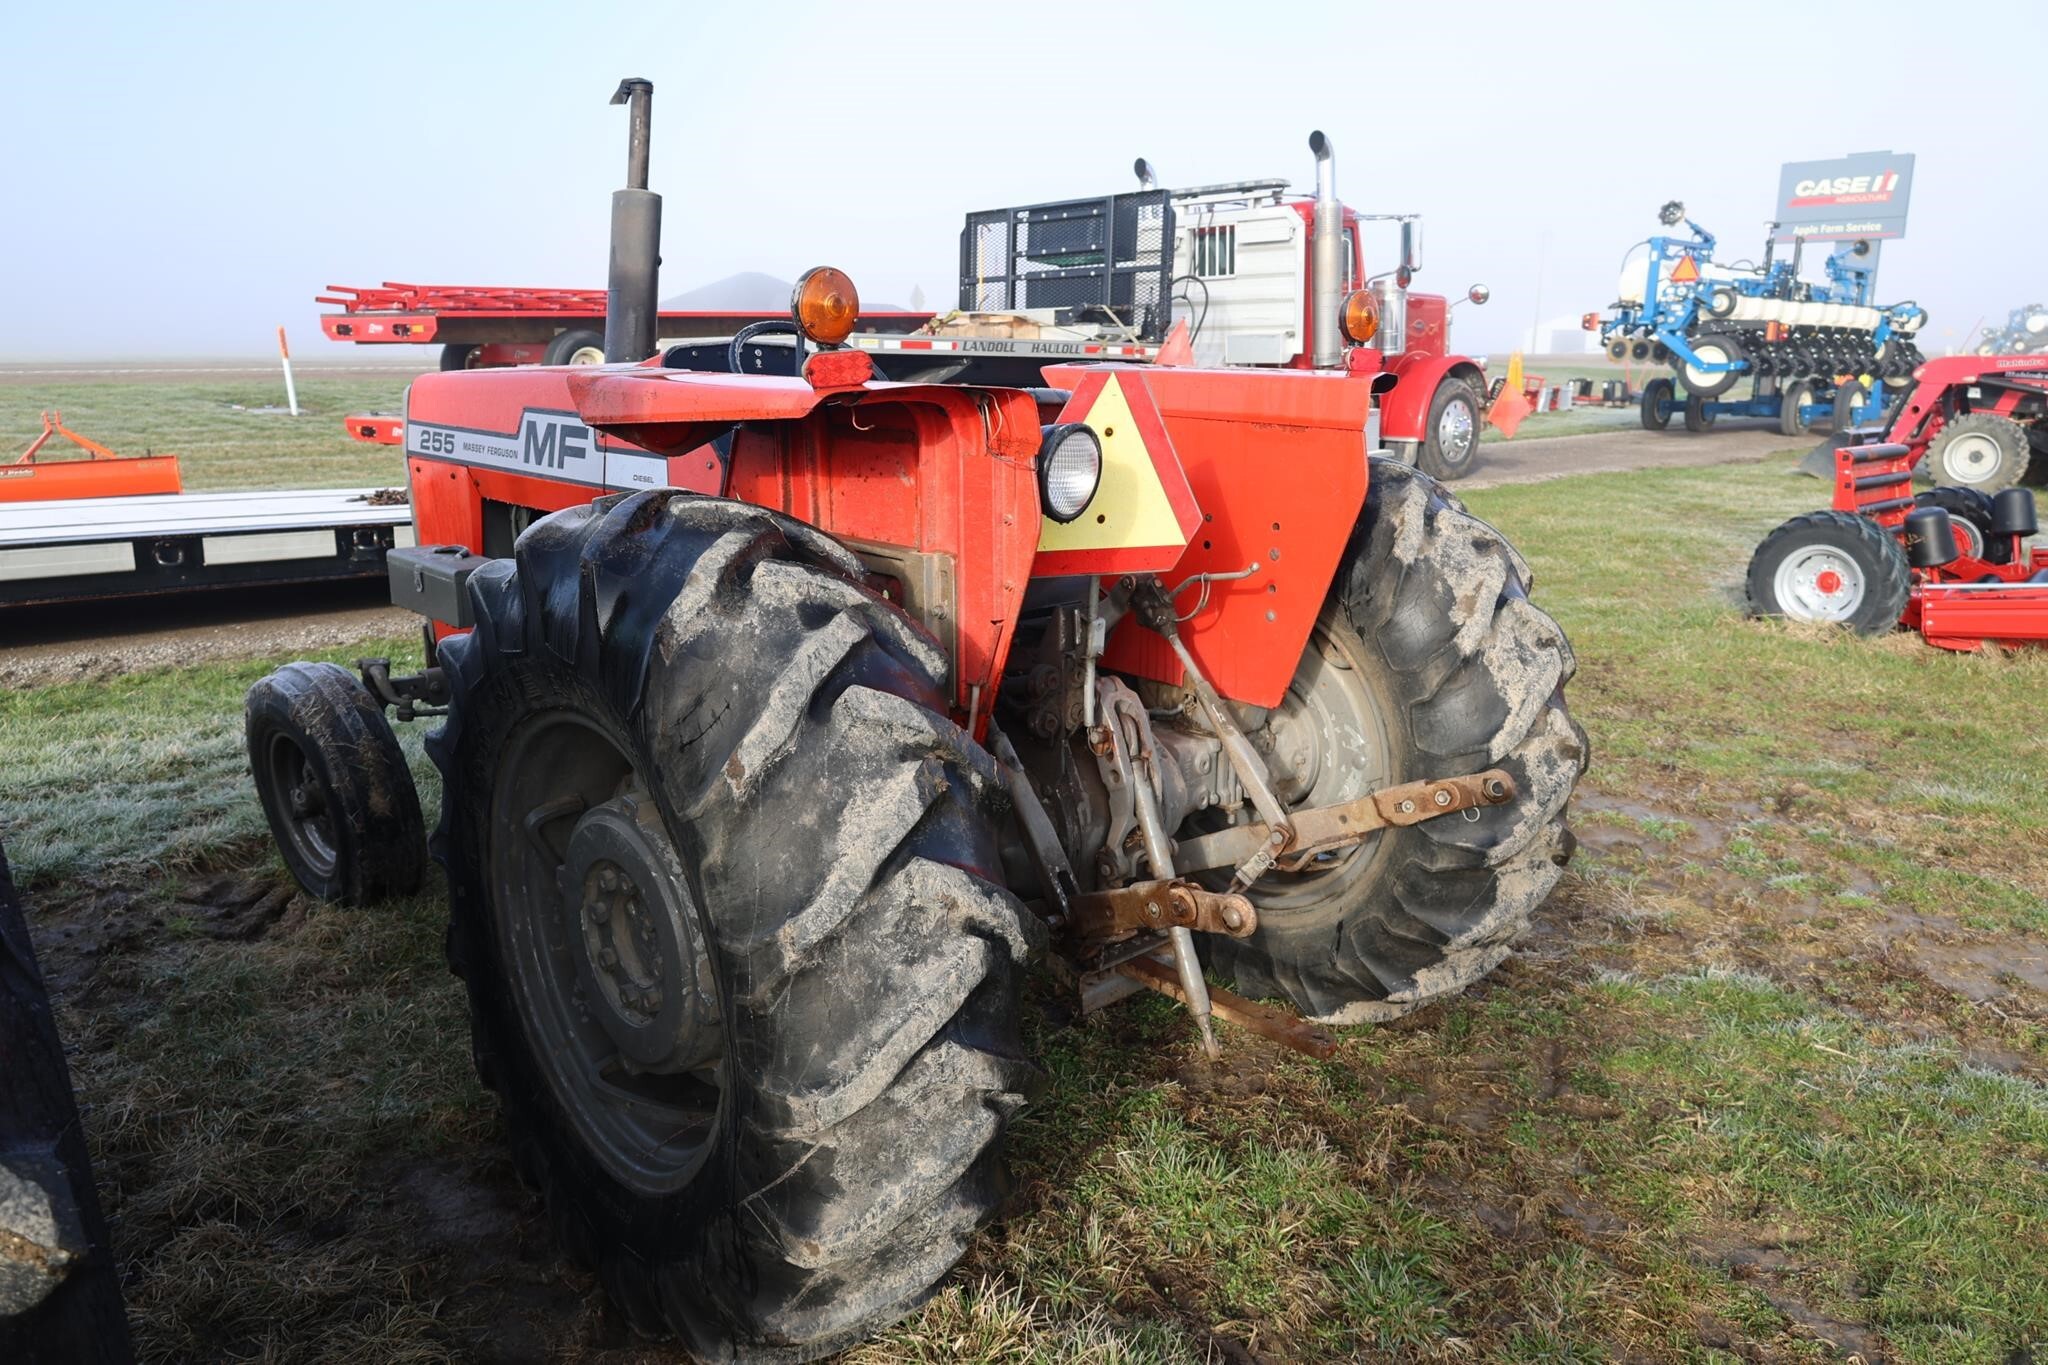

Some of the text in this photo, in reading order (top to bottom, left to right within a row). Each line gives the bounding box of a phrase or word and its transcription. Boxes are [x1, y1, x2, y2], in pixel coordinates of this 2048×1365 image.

[1795, 176, 1871, 197] CASE
[1793, 222, 1882, 236] Apple Farm Service
[962, 341, 1081, 354] LANDOLL HAULOLL
[420, 429, 455, 454] 255
[523, 420, 589, 469] MF
[463, 442, 518, 459] MASSEY FERGUSON
[633, 474, 654, 484] DIESEL
